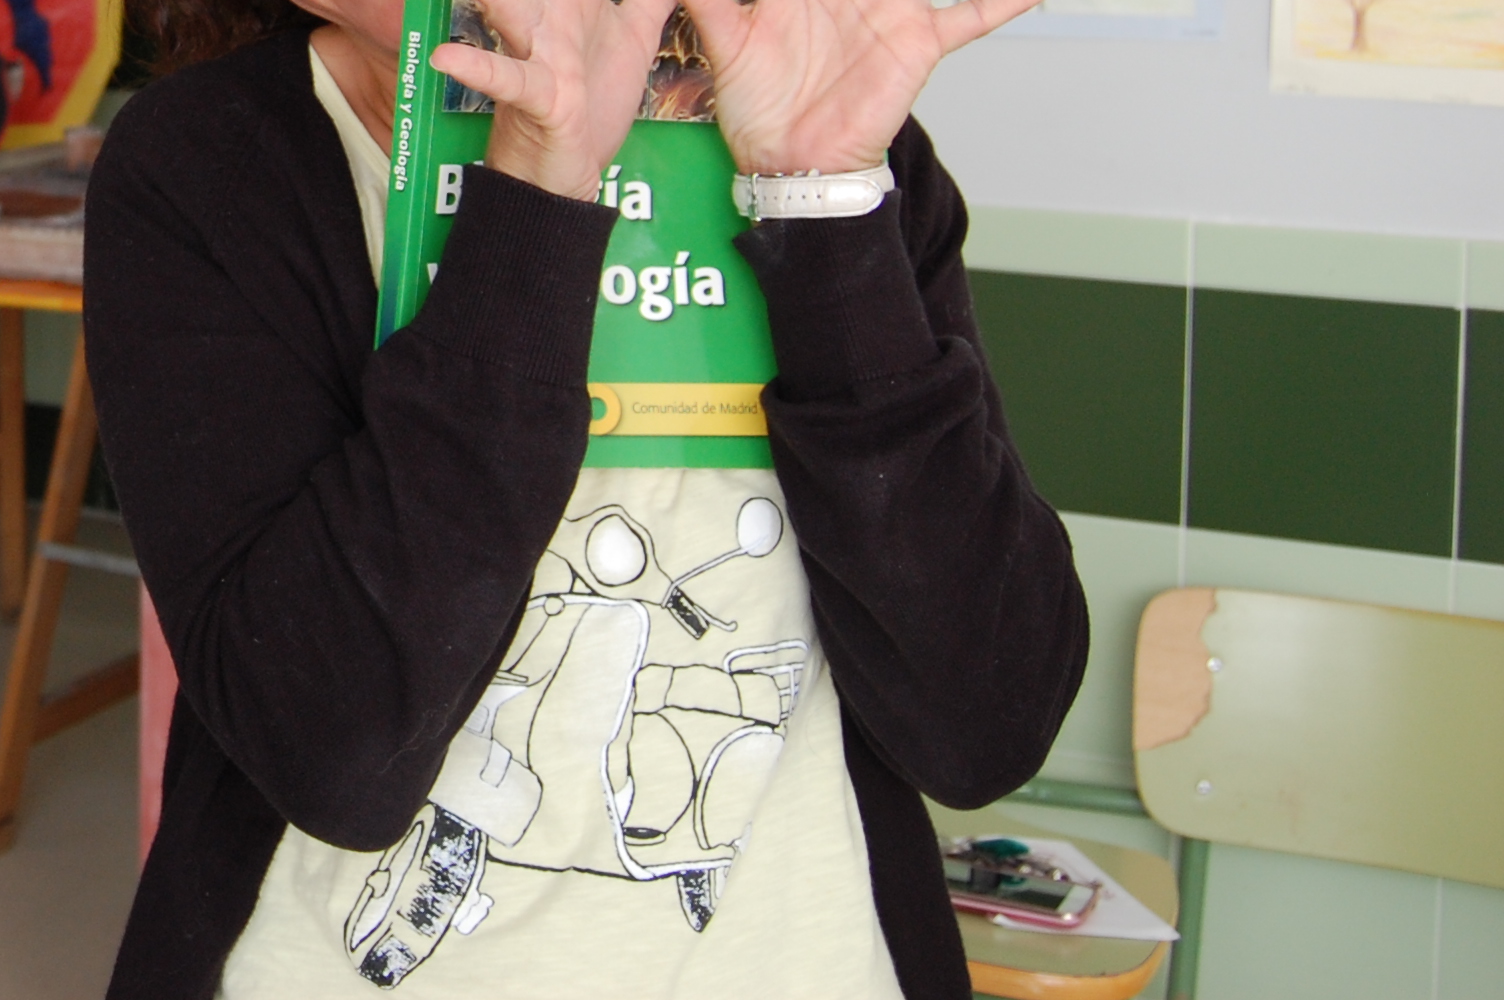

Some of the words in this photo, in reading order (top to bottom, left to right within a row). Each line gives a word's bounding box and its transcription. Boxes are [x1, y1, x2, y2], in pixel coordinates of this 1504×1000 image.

[401, 30, 422, 99] Biología
[399, 103, 412, 114] y
[394, 117, 413, 192] Geología
[601, 251, 726, 322] ogía
[632, 401, 699, 415] Comunidad
[702, 401, 717, 415] de
[719, 402, 759, 415] Madrid
